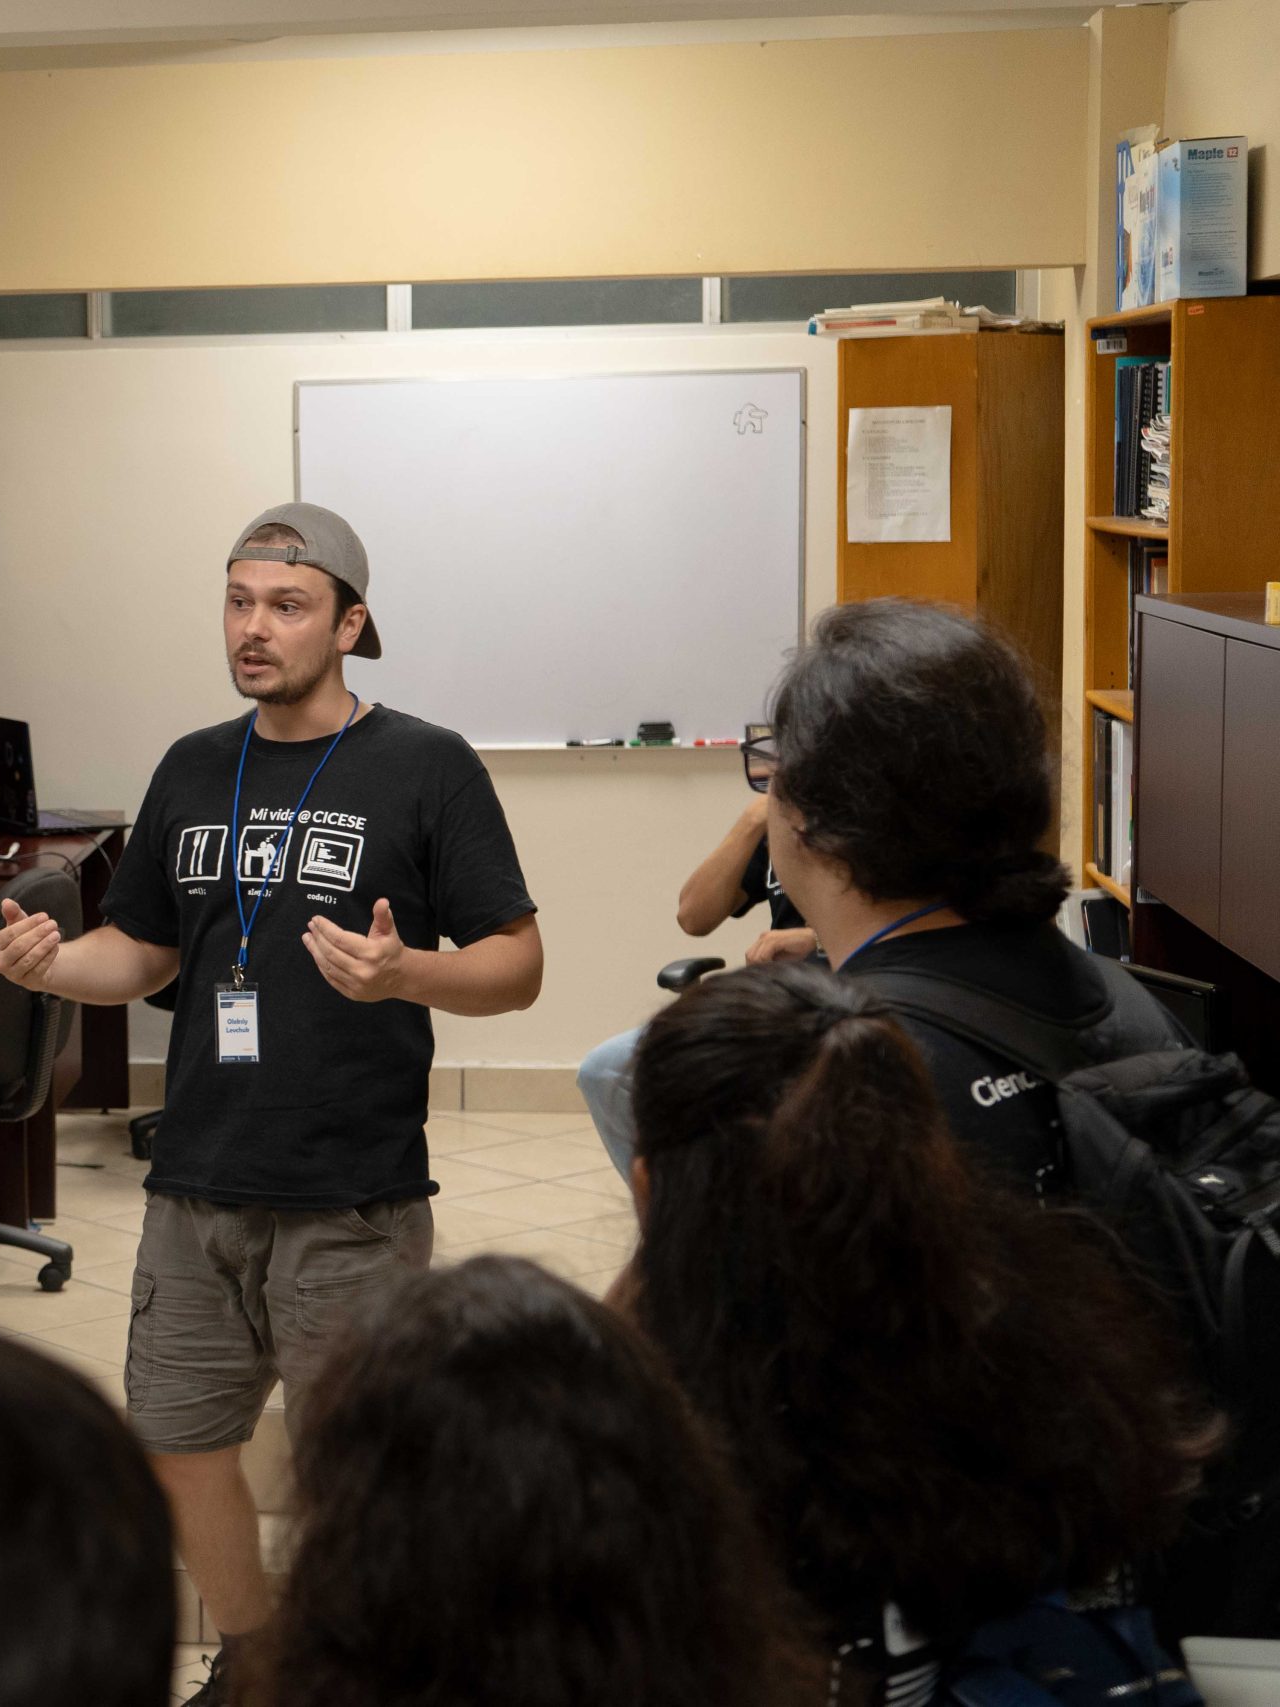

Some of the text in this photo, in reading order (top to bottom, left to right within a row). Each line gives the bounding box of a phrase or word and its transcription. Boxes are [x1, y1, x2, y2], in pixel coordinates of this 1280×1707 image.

[1188, 147, 1224, 160] Maple
[250, 807, 268, 822] Mi
[297, 811, 311, 824] @
[312, 810, 367, 831] CICESE
[306, 892, 338, 905] code();
